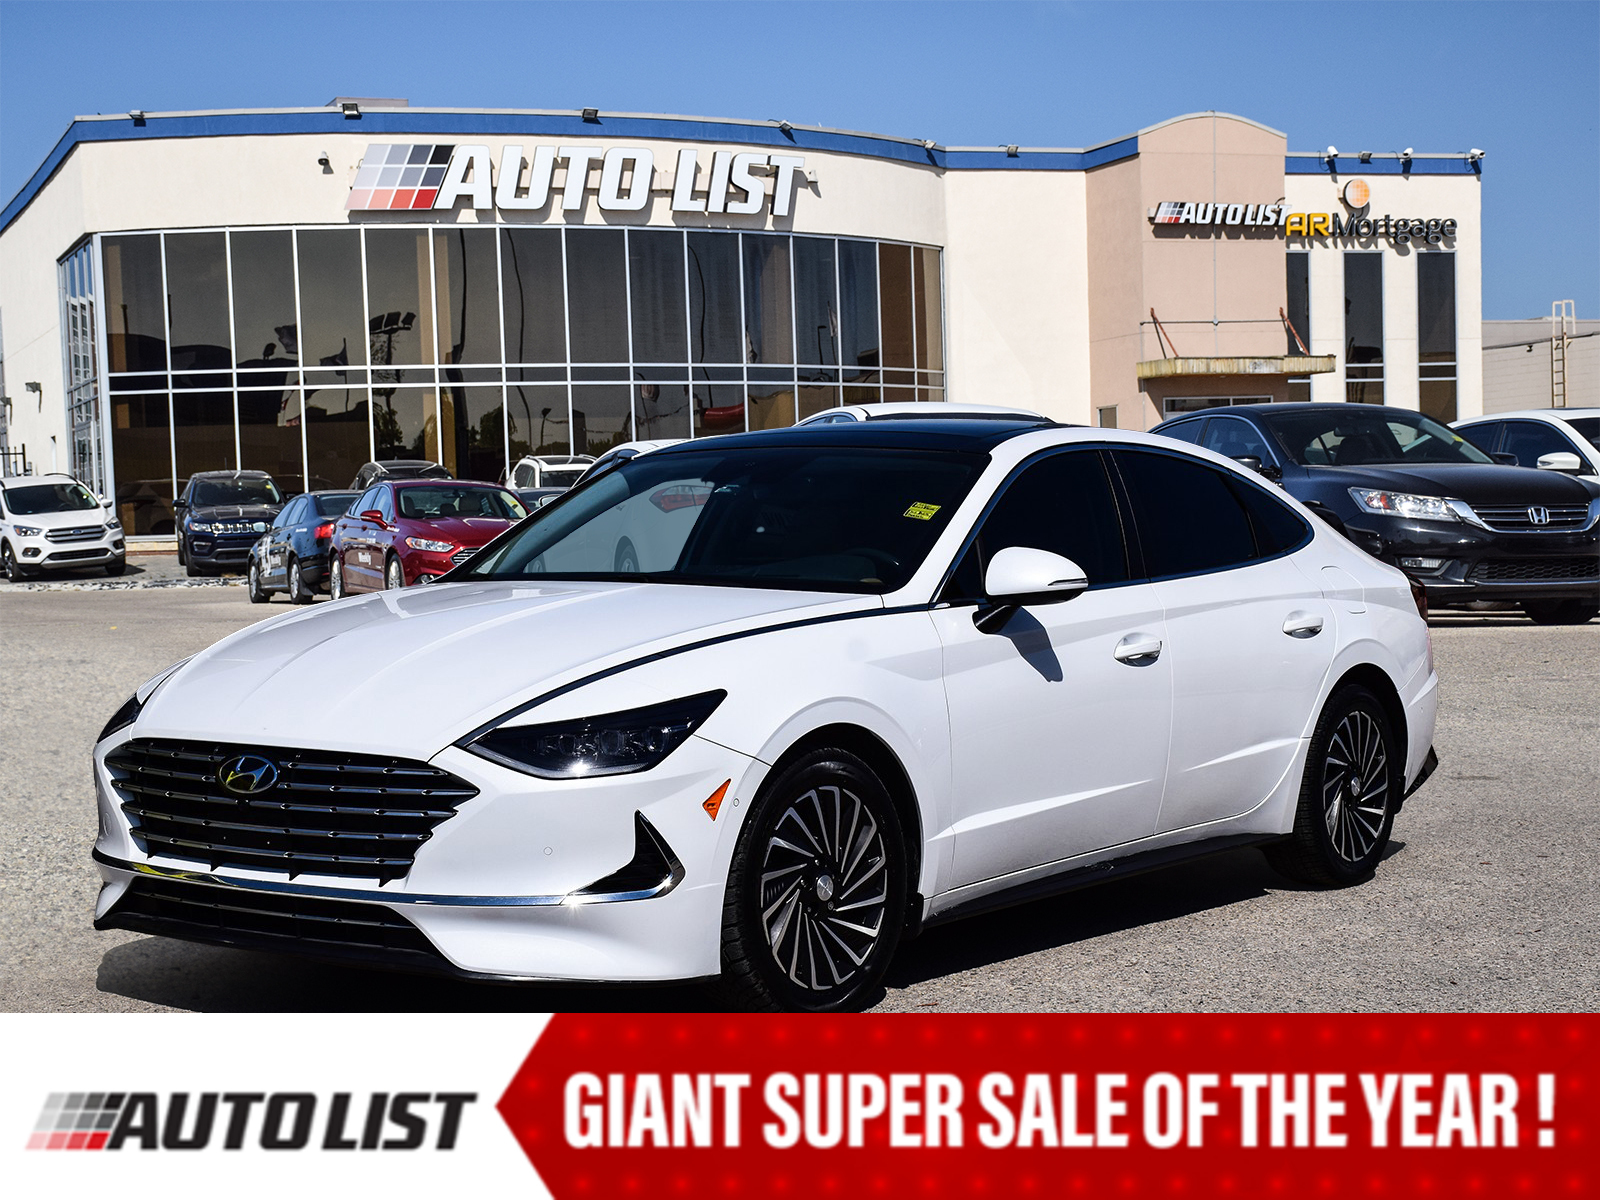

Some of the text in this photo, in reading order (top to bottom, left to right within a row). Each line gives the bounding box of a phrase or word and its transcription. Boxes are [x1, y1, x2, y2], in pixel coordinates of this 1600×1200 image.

[434, 144, 806, 217] AUTO LIST
[1179, 202, 1292, 226] AUTO LIST
